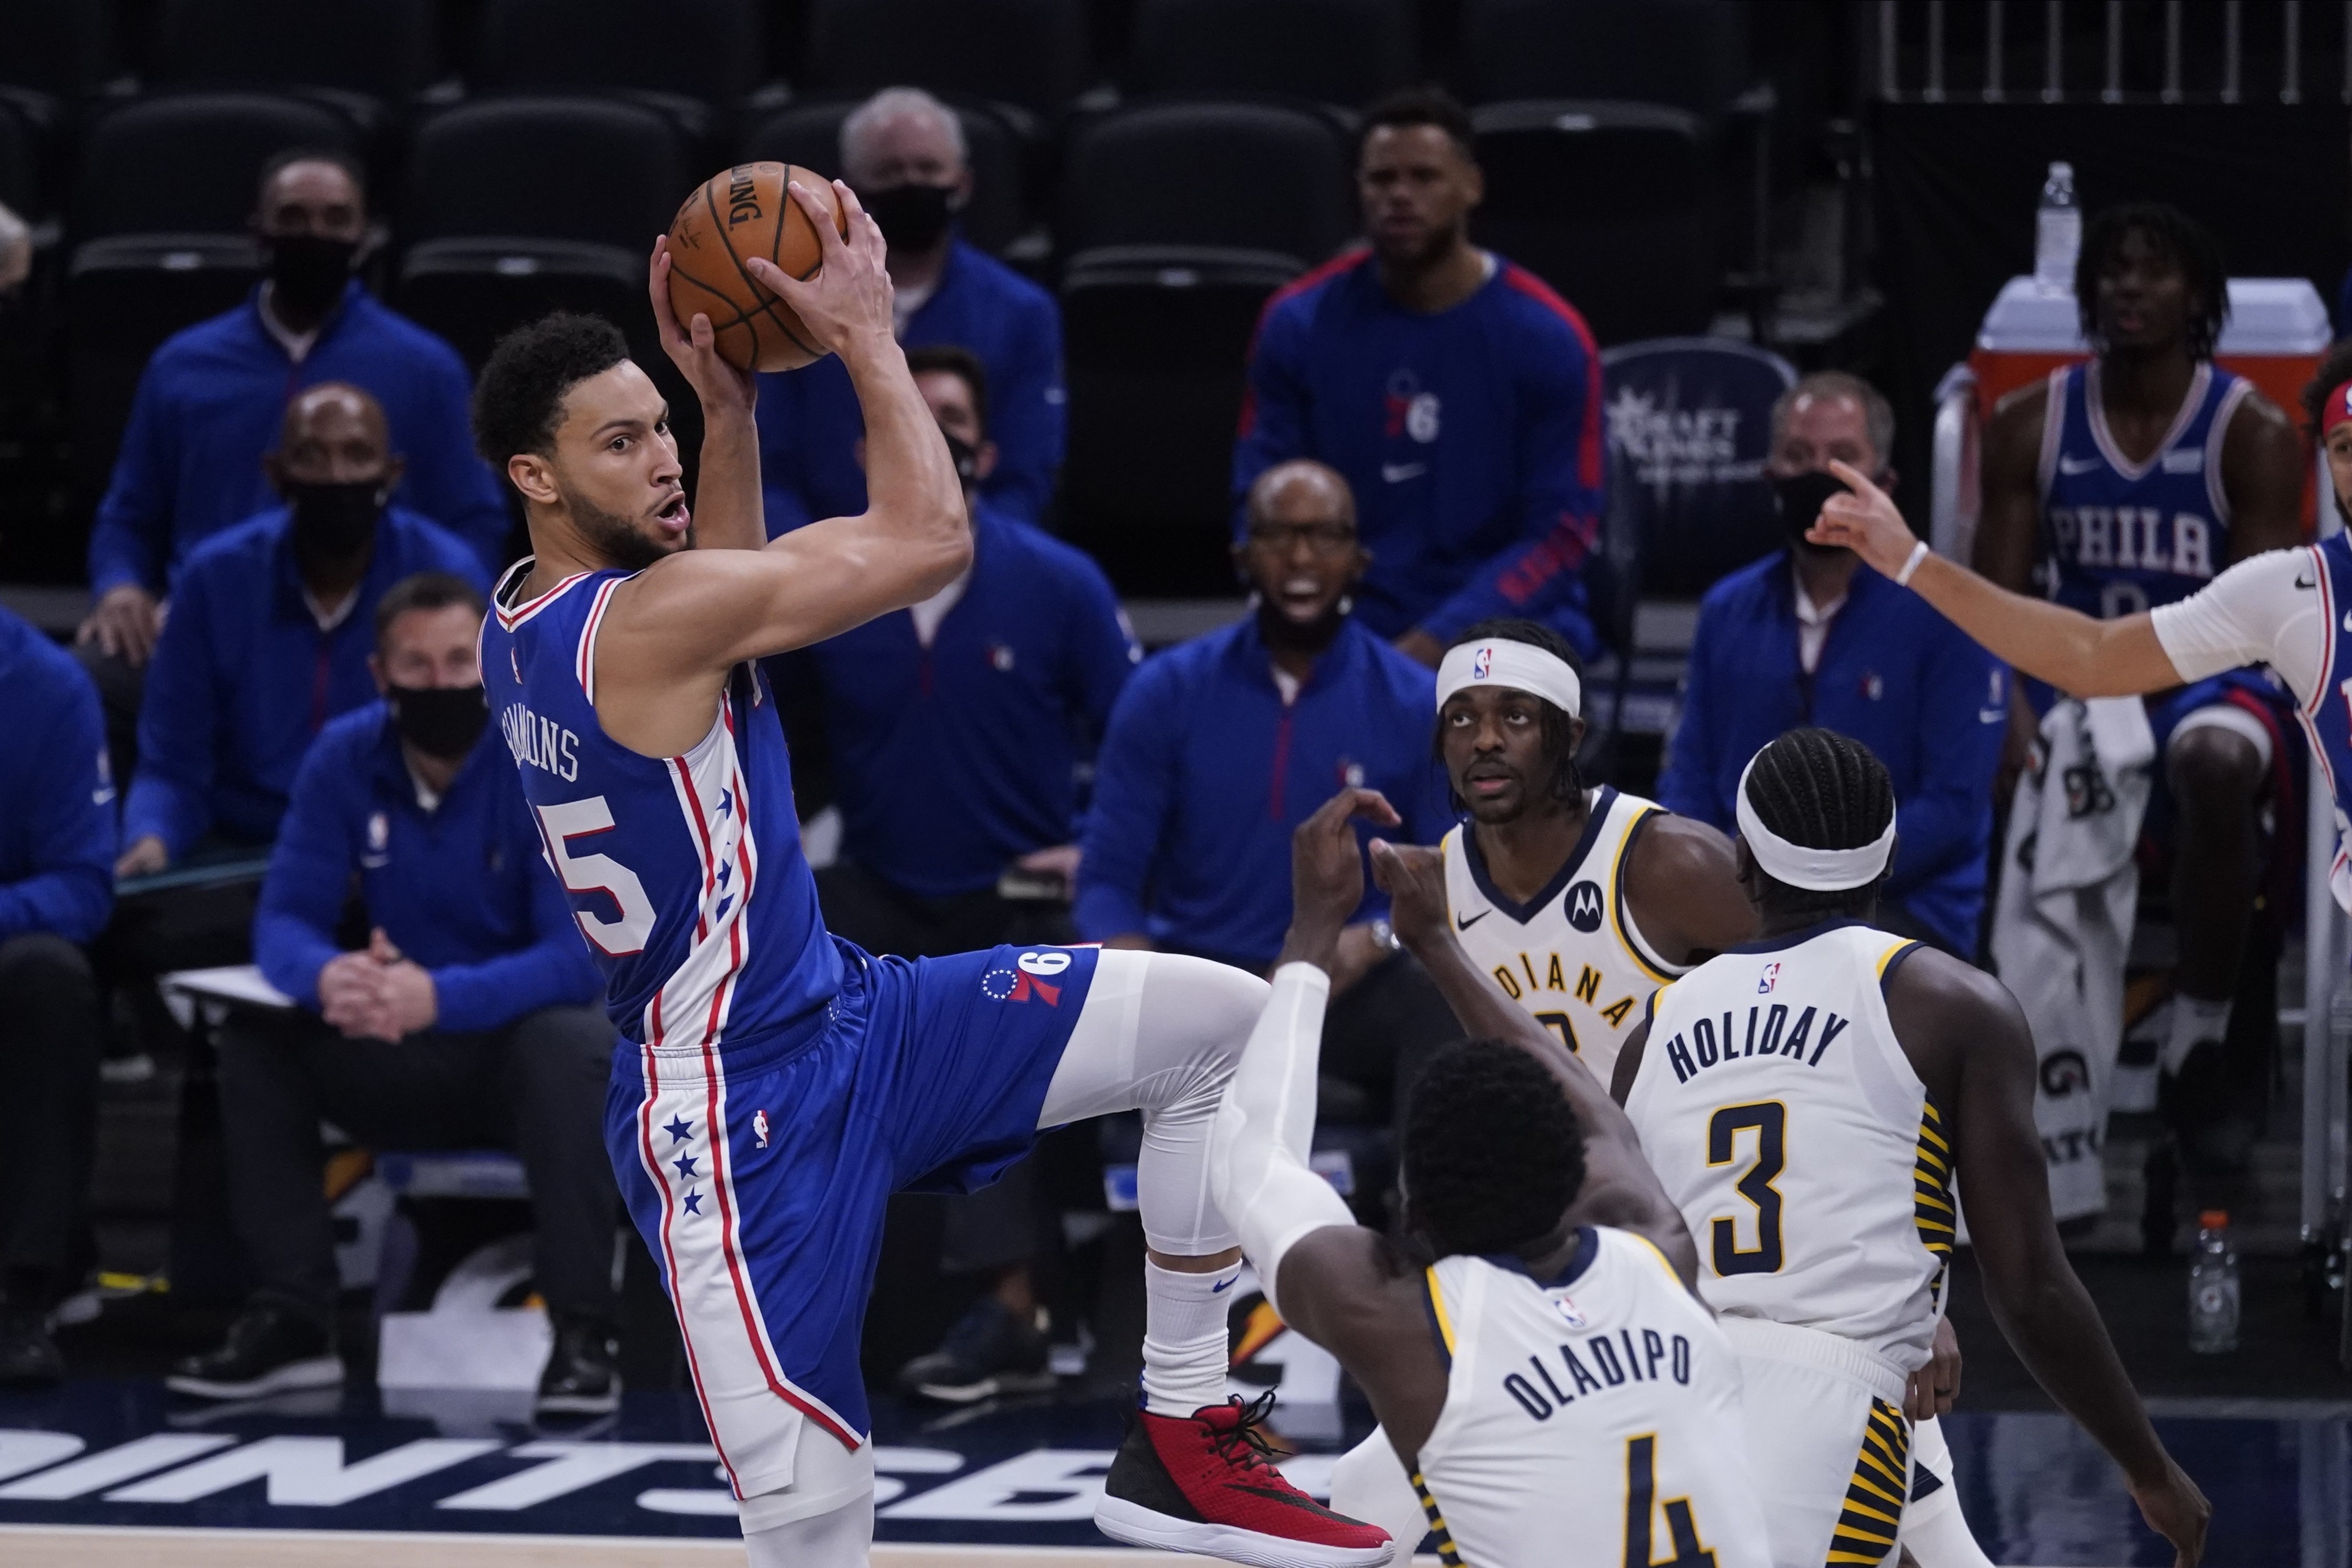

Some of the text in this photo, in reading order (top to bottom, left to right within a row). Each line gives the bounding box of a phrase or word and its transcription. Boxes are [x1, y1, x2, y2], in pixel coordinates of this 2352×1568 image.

[2049, 505, 2216, 579] PHILA
[525, 794, 657, 958] 5
[1492, 950, 1637, 1030] DIANA
[1666, 1004, 1850, 1084] HOLIDAY
[1707, 1098, 1788, 1278] 3
[1504, 1328, 1691, 1422] OLADIPO
[0, 1428, 1333, 1521] INTSB
[1622, 1431, 1721, 1568] 4
